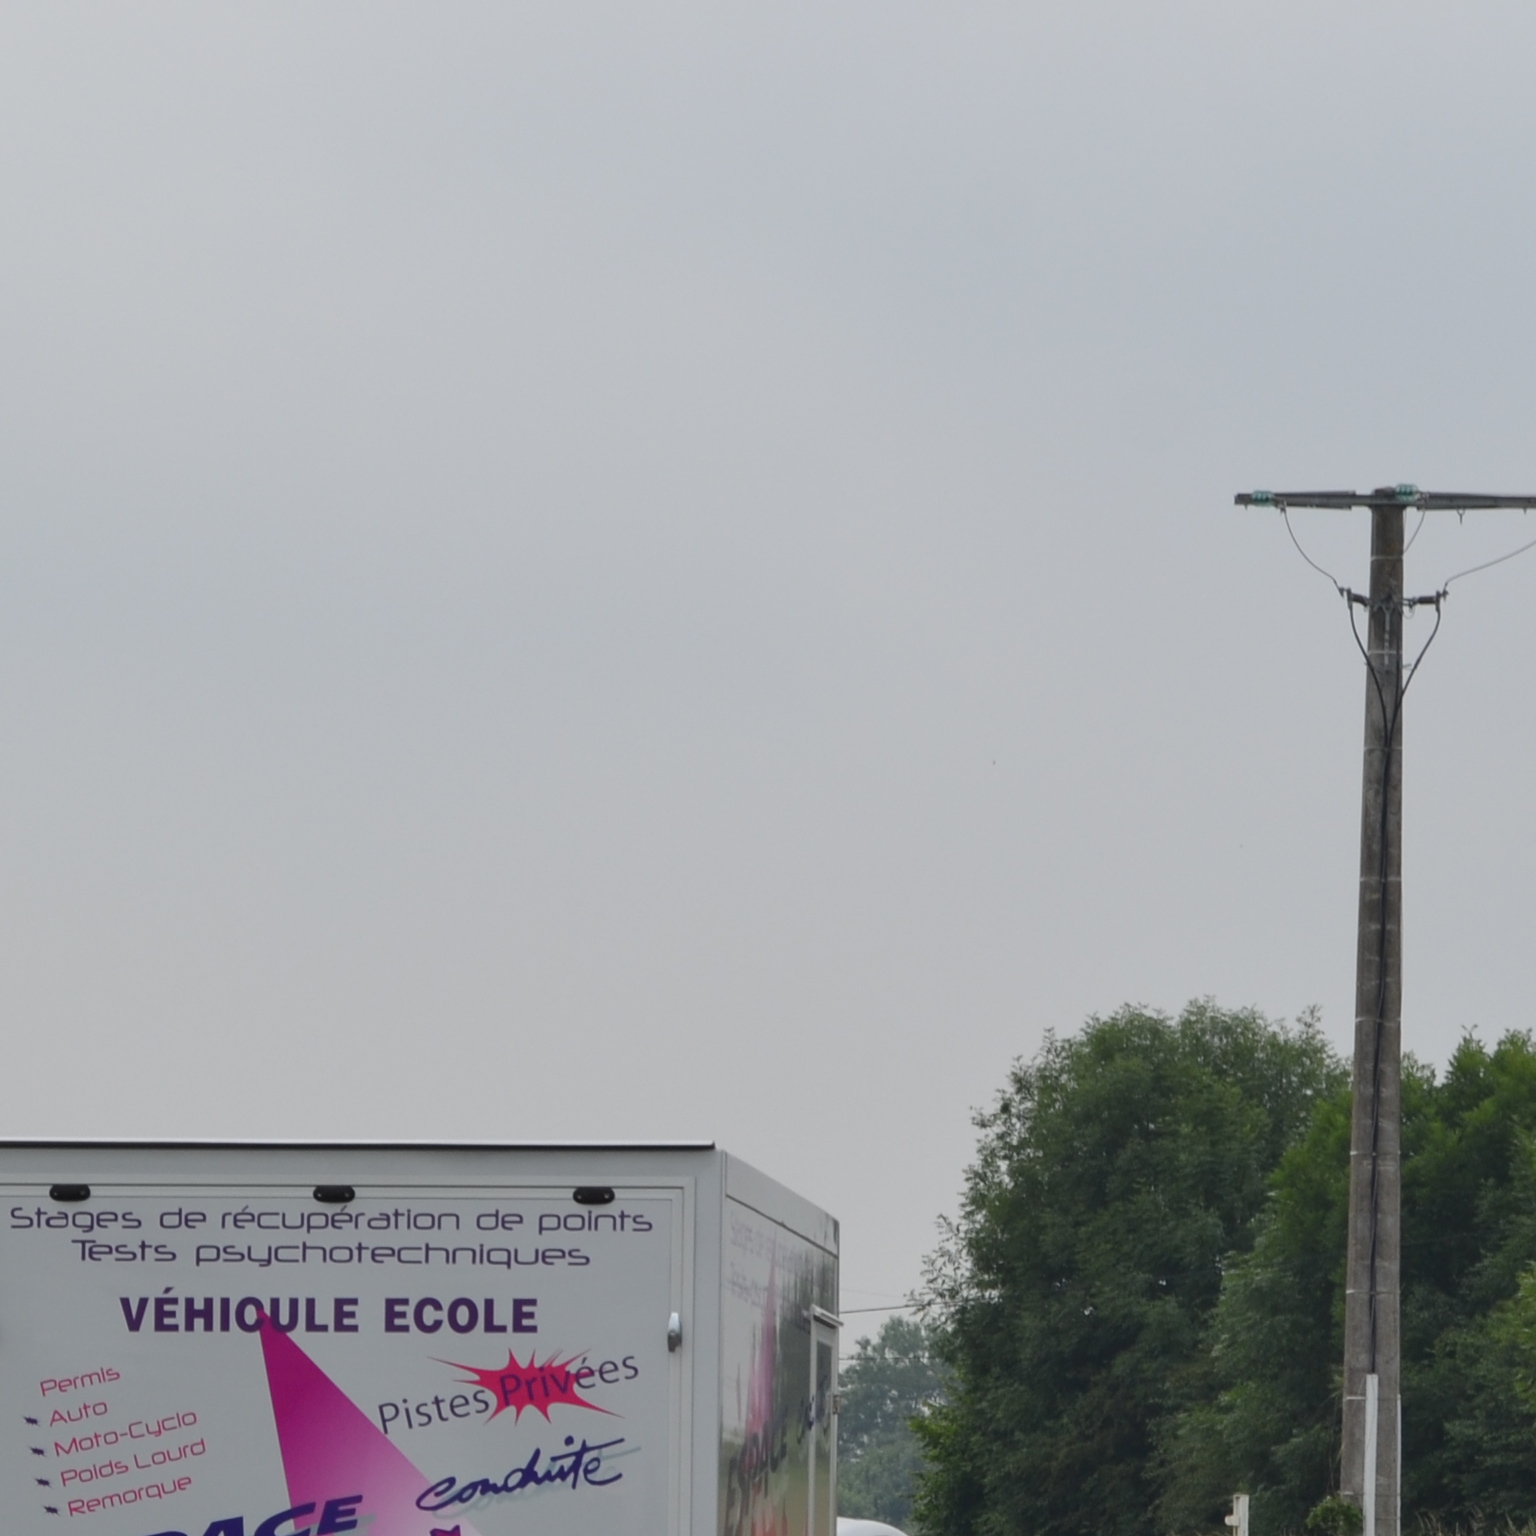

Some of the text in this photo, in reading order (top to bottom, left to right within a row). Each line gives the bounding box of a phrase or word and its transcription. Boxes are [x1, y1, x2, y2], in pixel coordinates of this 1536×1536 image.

[10, 1204, 654, 1236] Stages de récupération de points
[71, 1239, 591, 1270] Tests psychotechniques
[384, 1297, 539, 1335] ECOLE
[39, 1366, 121, 1397] Permis
[377, 1353, 640, 1435] Pistes Privées
[49, 1401, 109, 1428] Auto
[53, 1411, 198, 1458] Moto-Cyclo
[60, 1437, 207, 1487] Poids Lourd
[66, 1476, 193, 1517] Remorque
